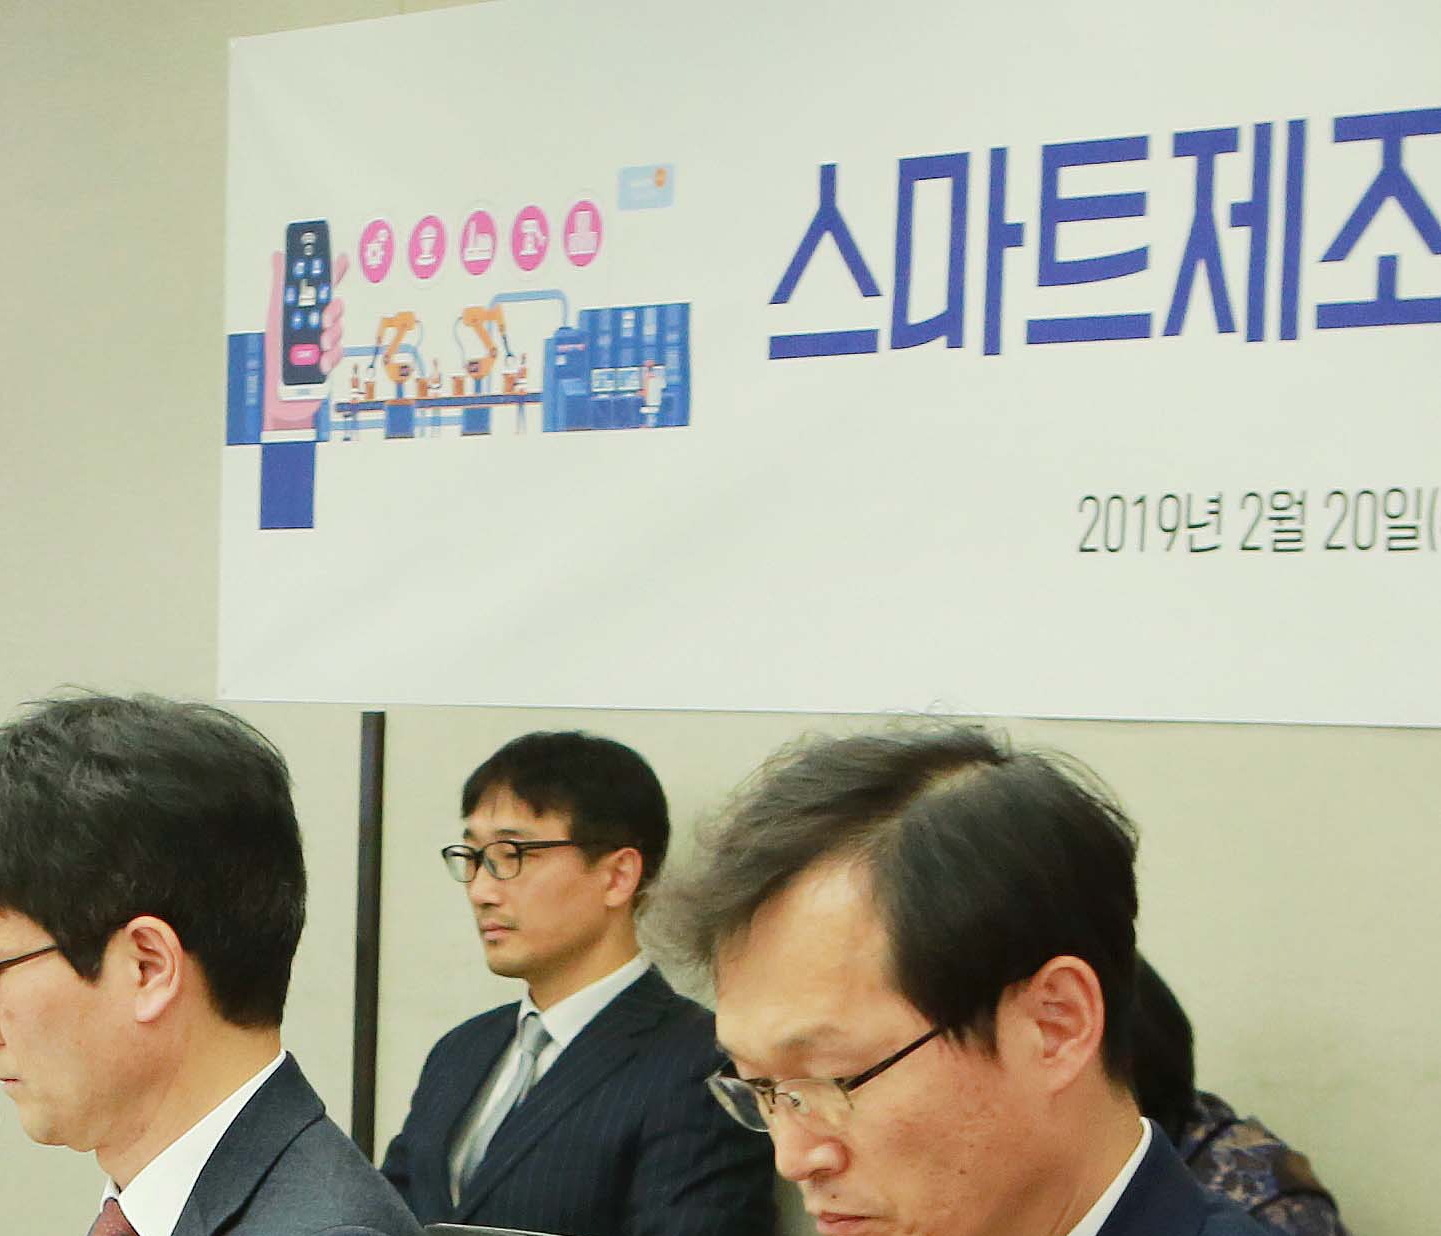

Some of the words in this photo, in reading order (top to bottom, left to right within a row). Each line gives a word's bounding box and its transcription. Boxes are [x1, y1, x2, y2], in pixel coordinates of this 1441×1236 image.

[768, 106, 1441, 360] 스마트제조
[1077, 491, 1222, 552] 2019년
[1239, 489, 1306, 552] 2월
